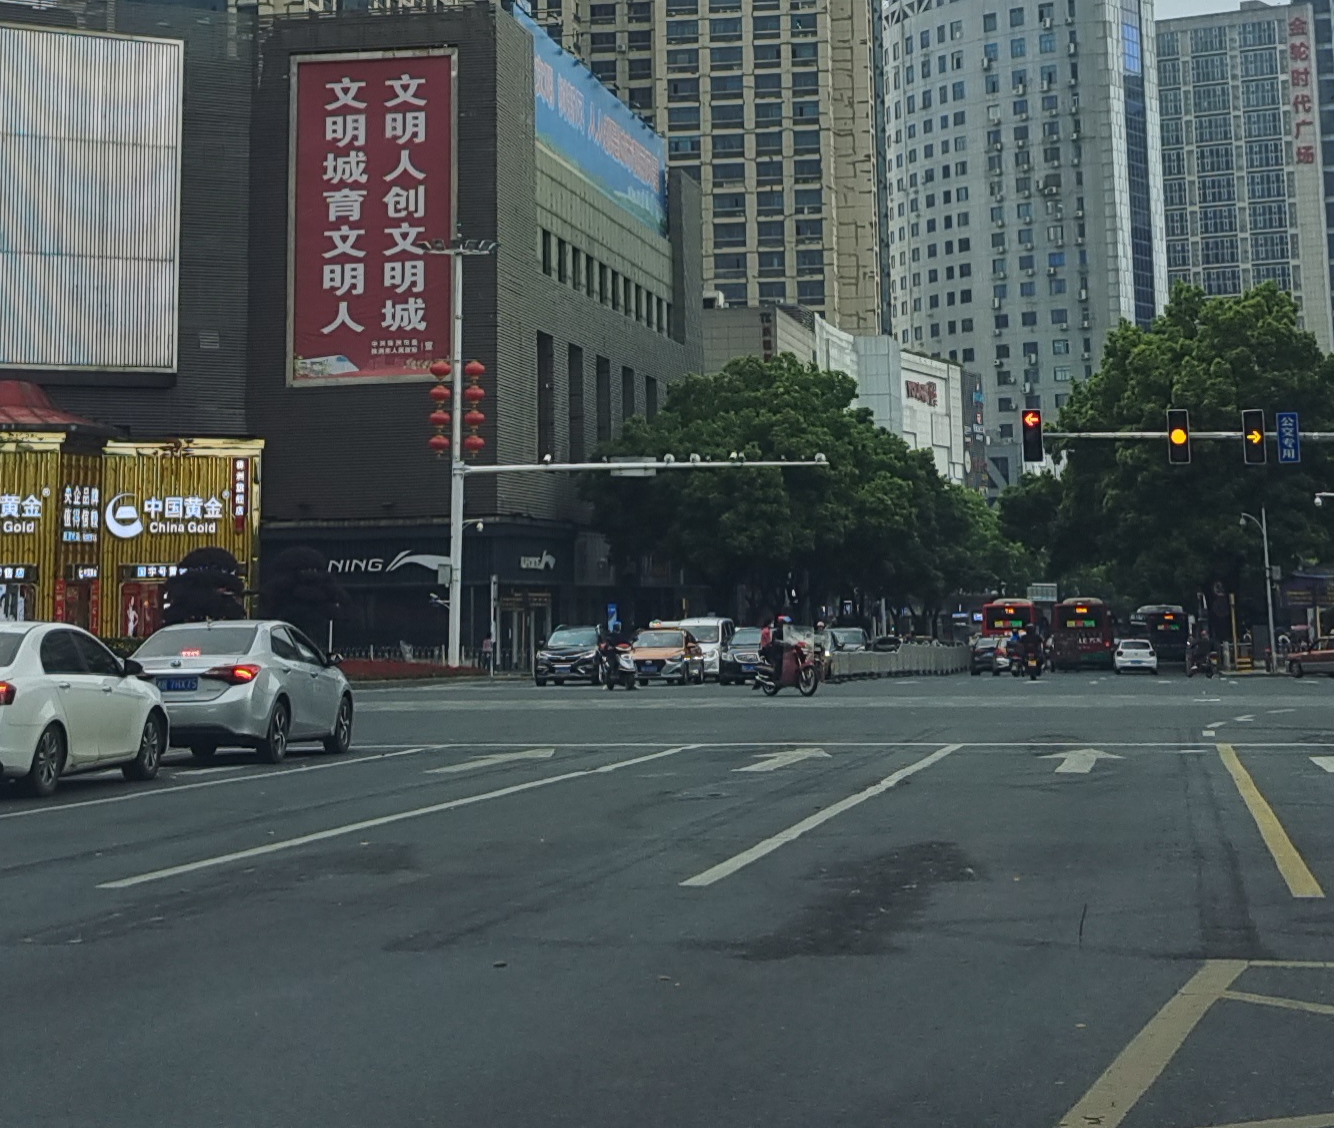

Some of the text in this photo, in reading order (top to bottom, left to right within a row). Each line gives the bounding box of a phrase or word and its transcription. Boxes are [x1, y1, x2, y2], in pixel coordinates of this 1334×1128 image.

[1288, 17, 1315, 165] 金轮时代广场
[321, 76, 368, 335] 文明城育文明人
[381, 73, 427, 332] 文明人创文明城
[3, 520, 35, 534] Gold
[143, 496, 223, 520] 中国黄金
[149, 521, 216, 534] China Gold
